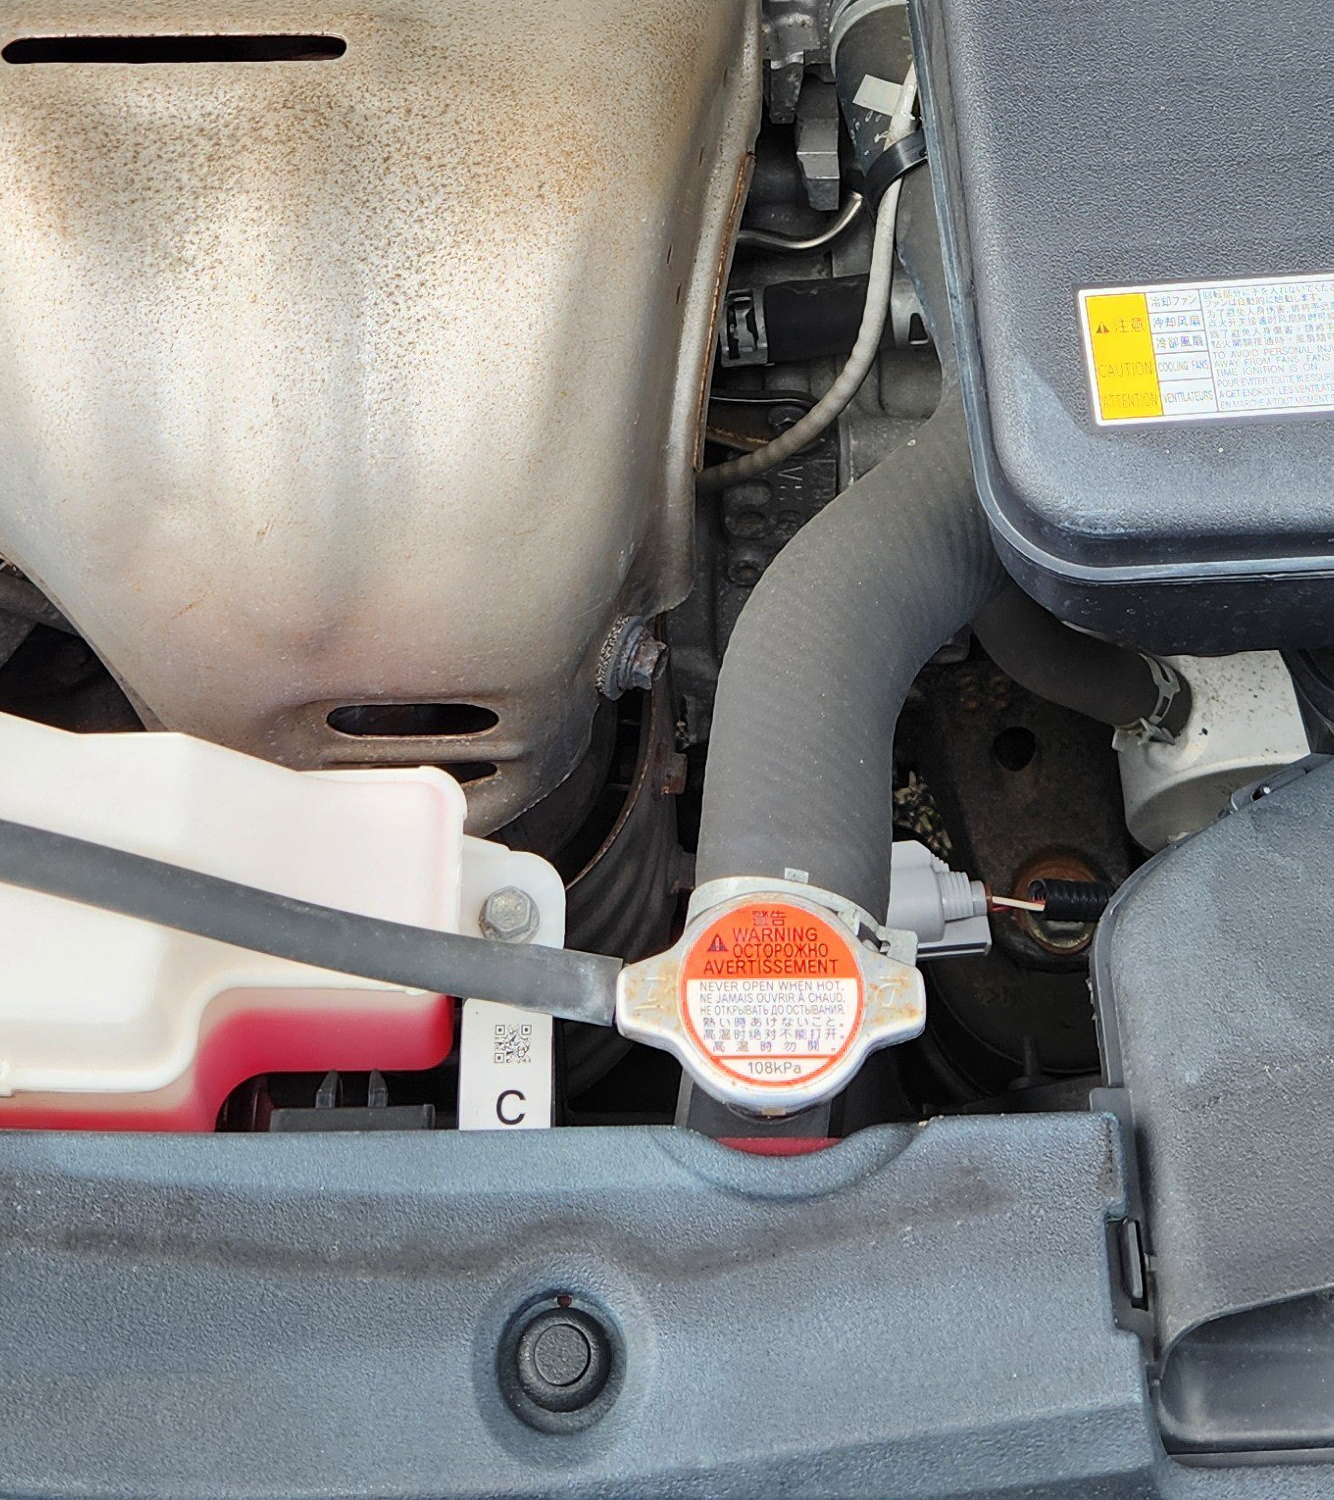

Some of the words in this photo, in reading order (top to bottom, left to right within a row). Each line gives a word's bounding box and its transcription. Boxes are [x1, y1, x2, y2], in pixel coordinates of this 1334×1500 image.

[1212, 351, 1225, 359] TO
[1230, 349, 1259, 358] AVOID
[1263, 345, 1313, 356] PERSONAL
[1098, 360, 1153, 378] CAUTION
[1158, 360, 1188, 372] COOLING
[1213, 359, 1240, 368] AWAY
[1243, 357, 1271, 366] FROM
[1215, 368, 1238, 377] TIME
[1242, 365, 1284, 375] IGNITION
[1289, 364, 1298, 372] IS
[732, 928, 818, 942] WARNING
[733, 943, 828, 958] ОСТОРОЖНО
[704, 959, 839, 974] AVERTISSEMENT
[700, 981, 738, 991] NEVER
[743, 981, 774, 991] OPEN
[779, 981, 812, 991] WHEN
[817, 981, 845, 991] HOT.
[700, 993, 712, 1003] NE
[716, 993, 753, 1003] JAMAIS
[756, 993, 795, 1003] OUVRIR
[748, 1061, 802, 1075] 108kPa
[495, 1089, 527, 1126] C
